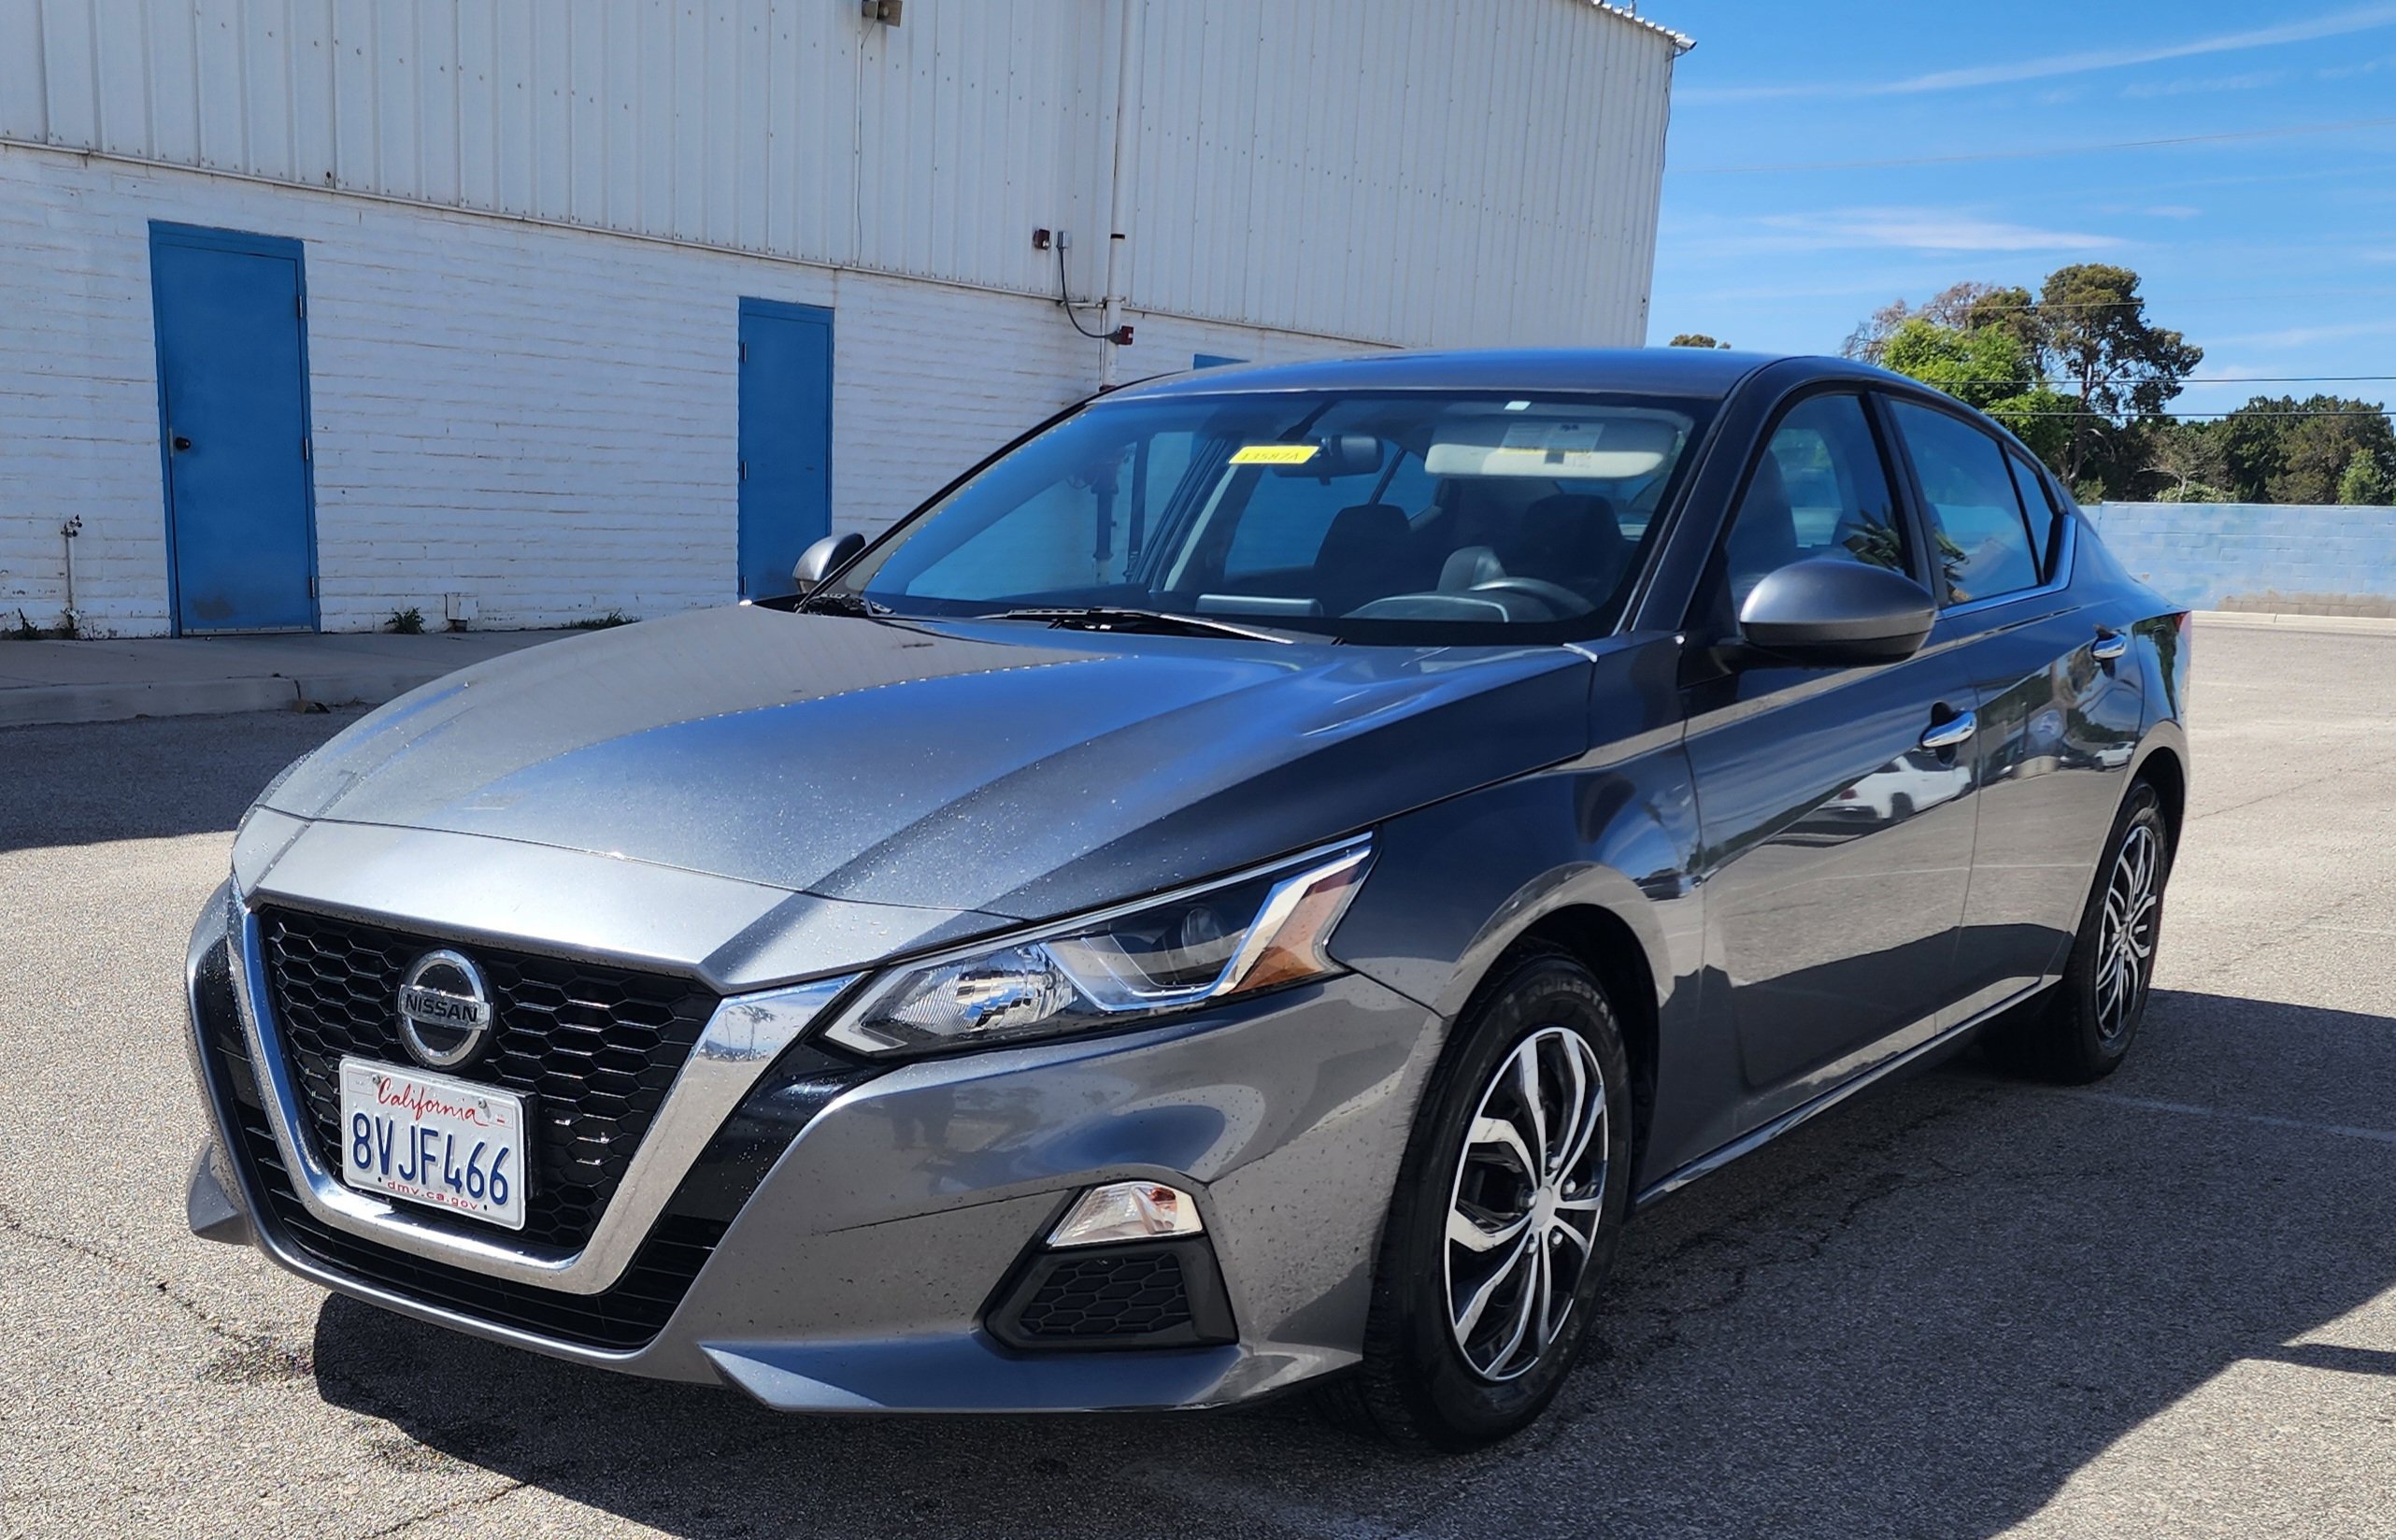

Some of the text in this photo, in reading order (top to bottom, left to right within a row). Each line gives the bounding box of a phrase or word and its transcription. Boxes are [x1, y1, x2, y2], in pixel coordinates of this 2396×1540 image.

[405, 992, 478, 1023] NISSAN
[377, 1077, 489, 1127] California
[351, 1111, 509, 1206] 8VJF466
[387, 1180, 478, 1210] dmv.ca.gov
